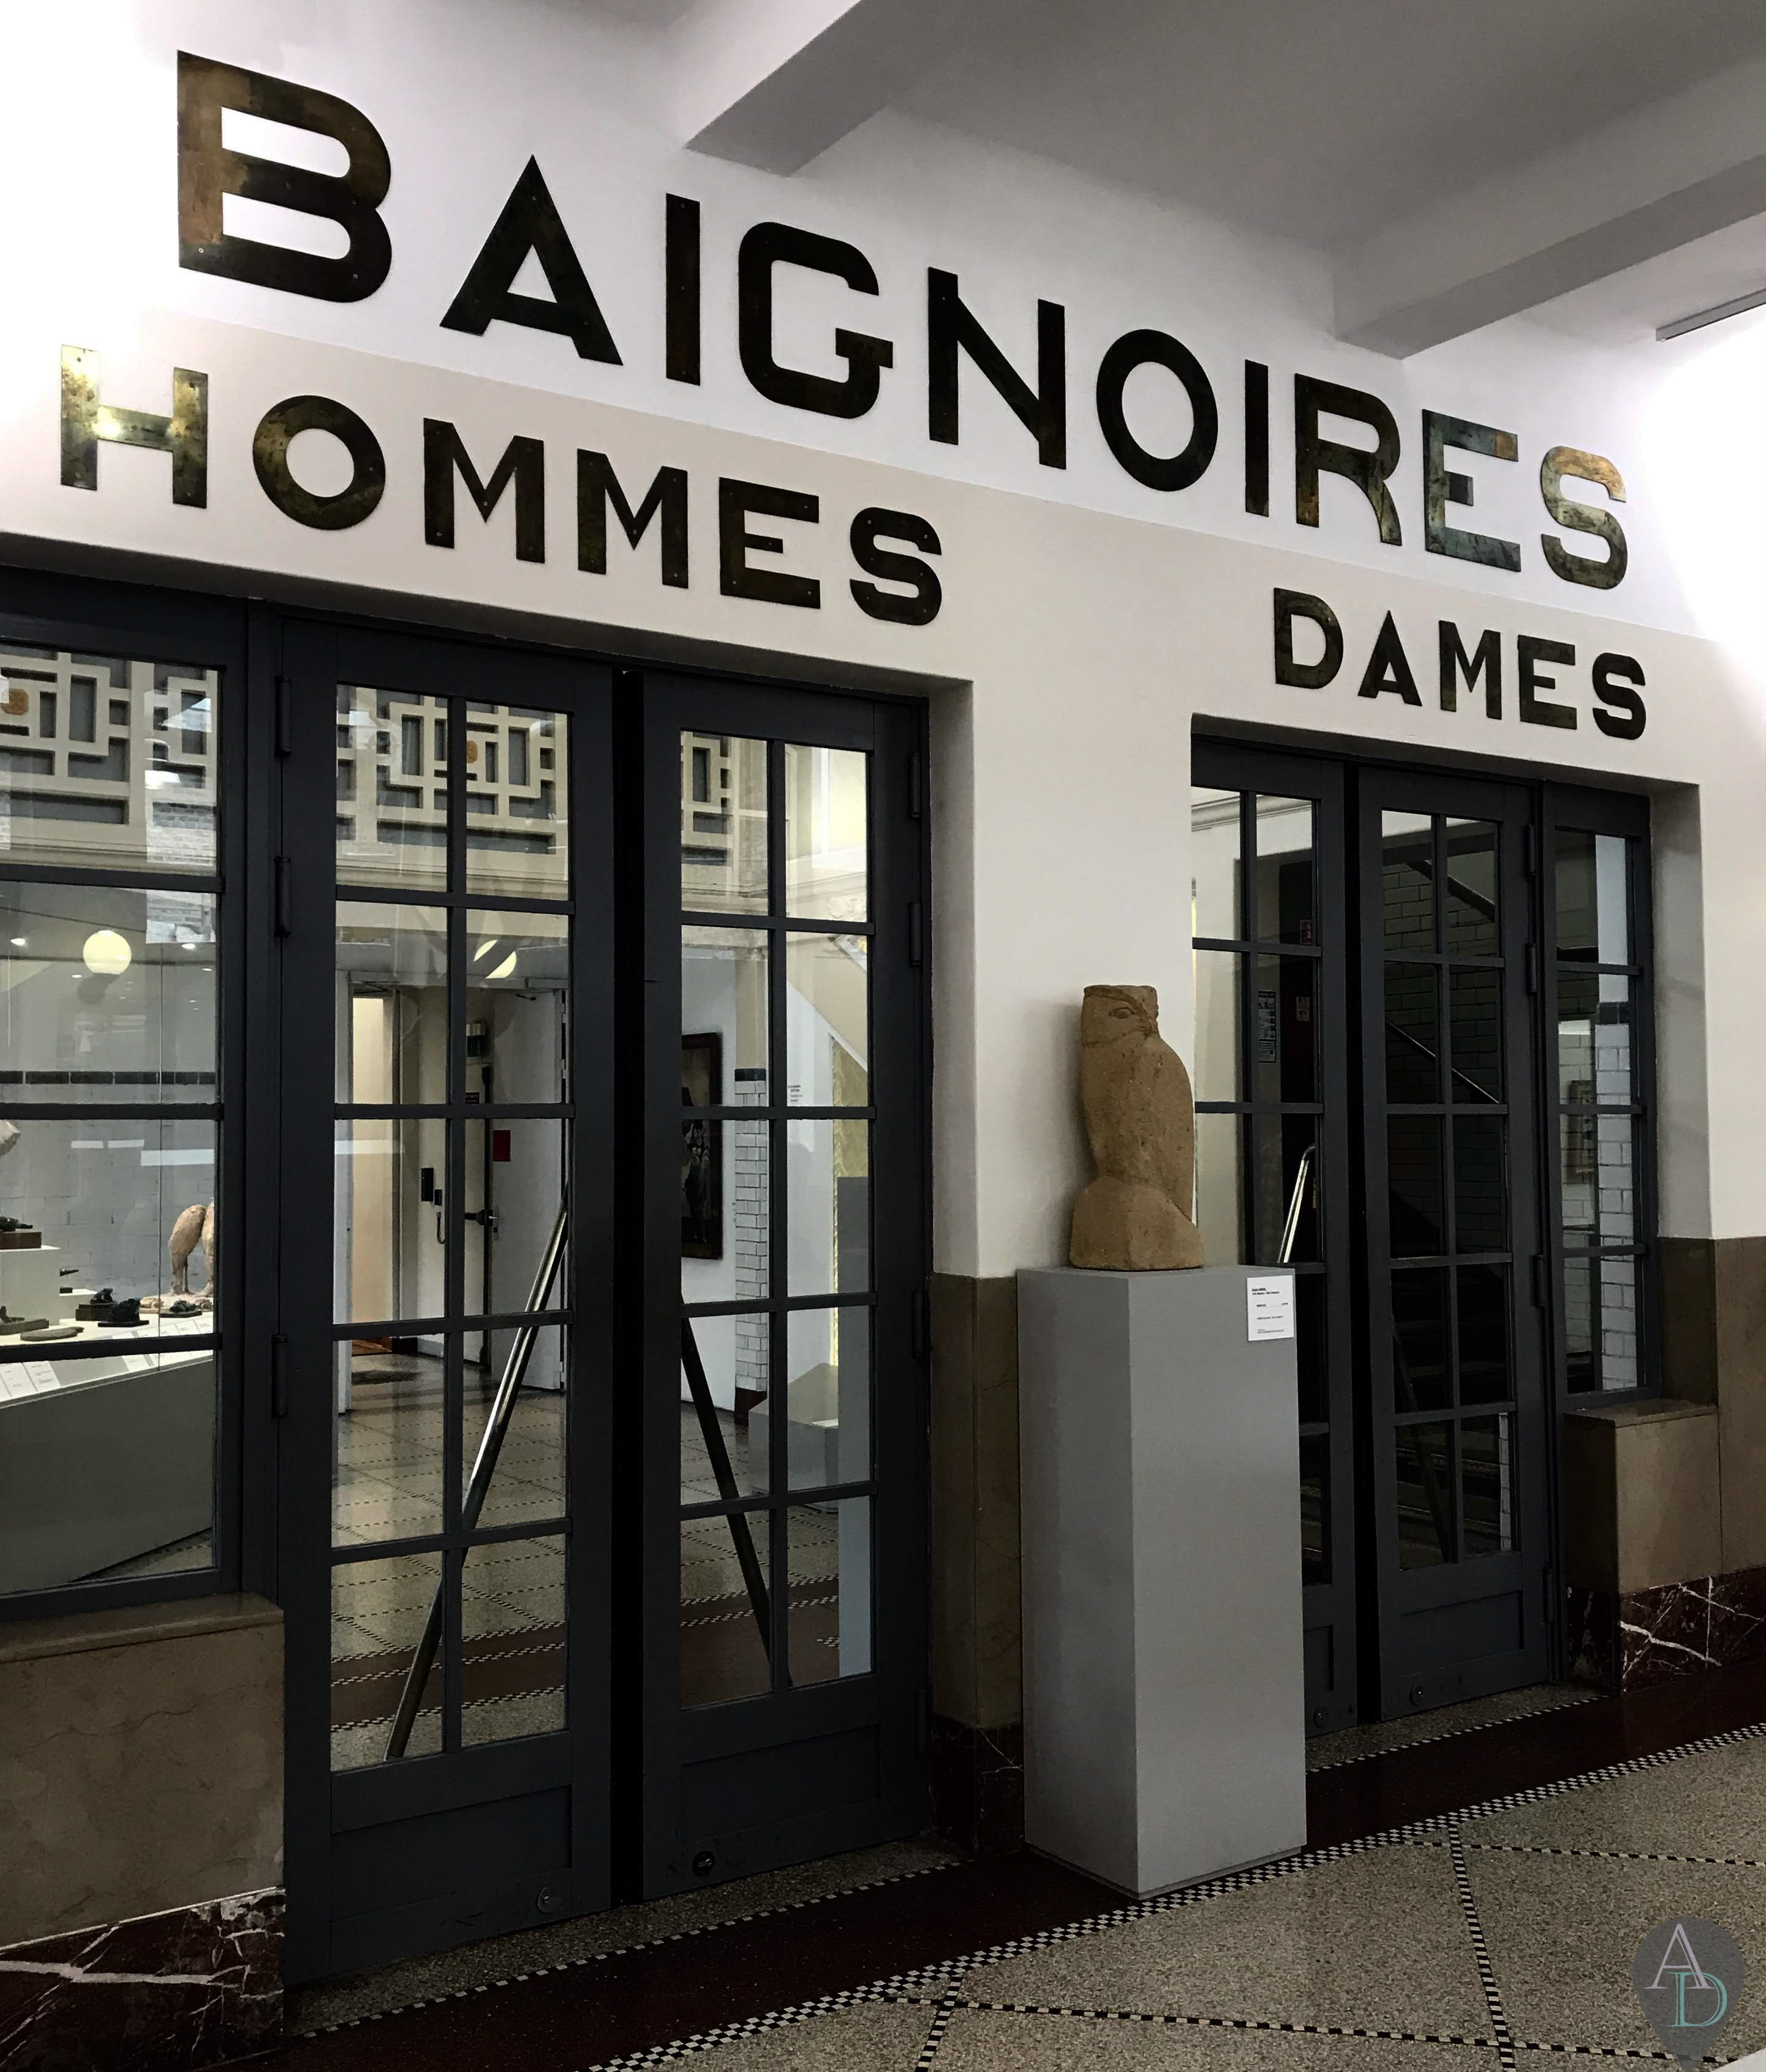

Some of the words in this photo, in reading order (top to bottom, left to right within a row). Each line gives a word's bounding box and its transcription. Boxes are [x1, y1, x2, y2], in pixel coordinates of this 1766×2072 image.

[178, 50, 1628, 590] BAIGNOIRES
[61, 344, 942, 626] HOMMES
[1274, 587, 1647, 740] DAMES
